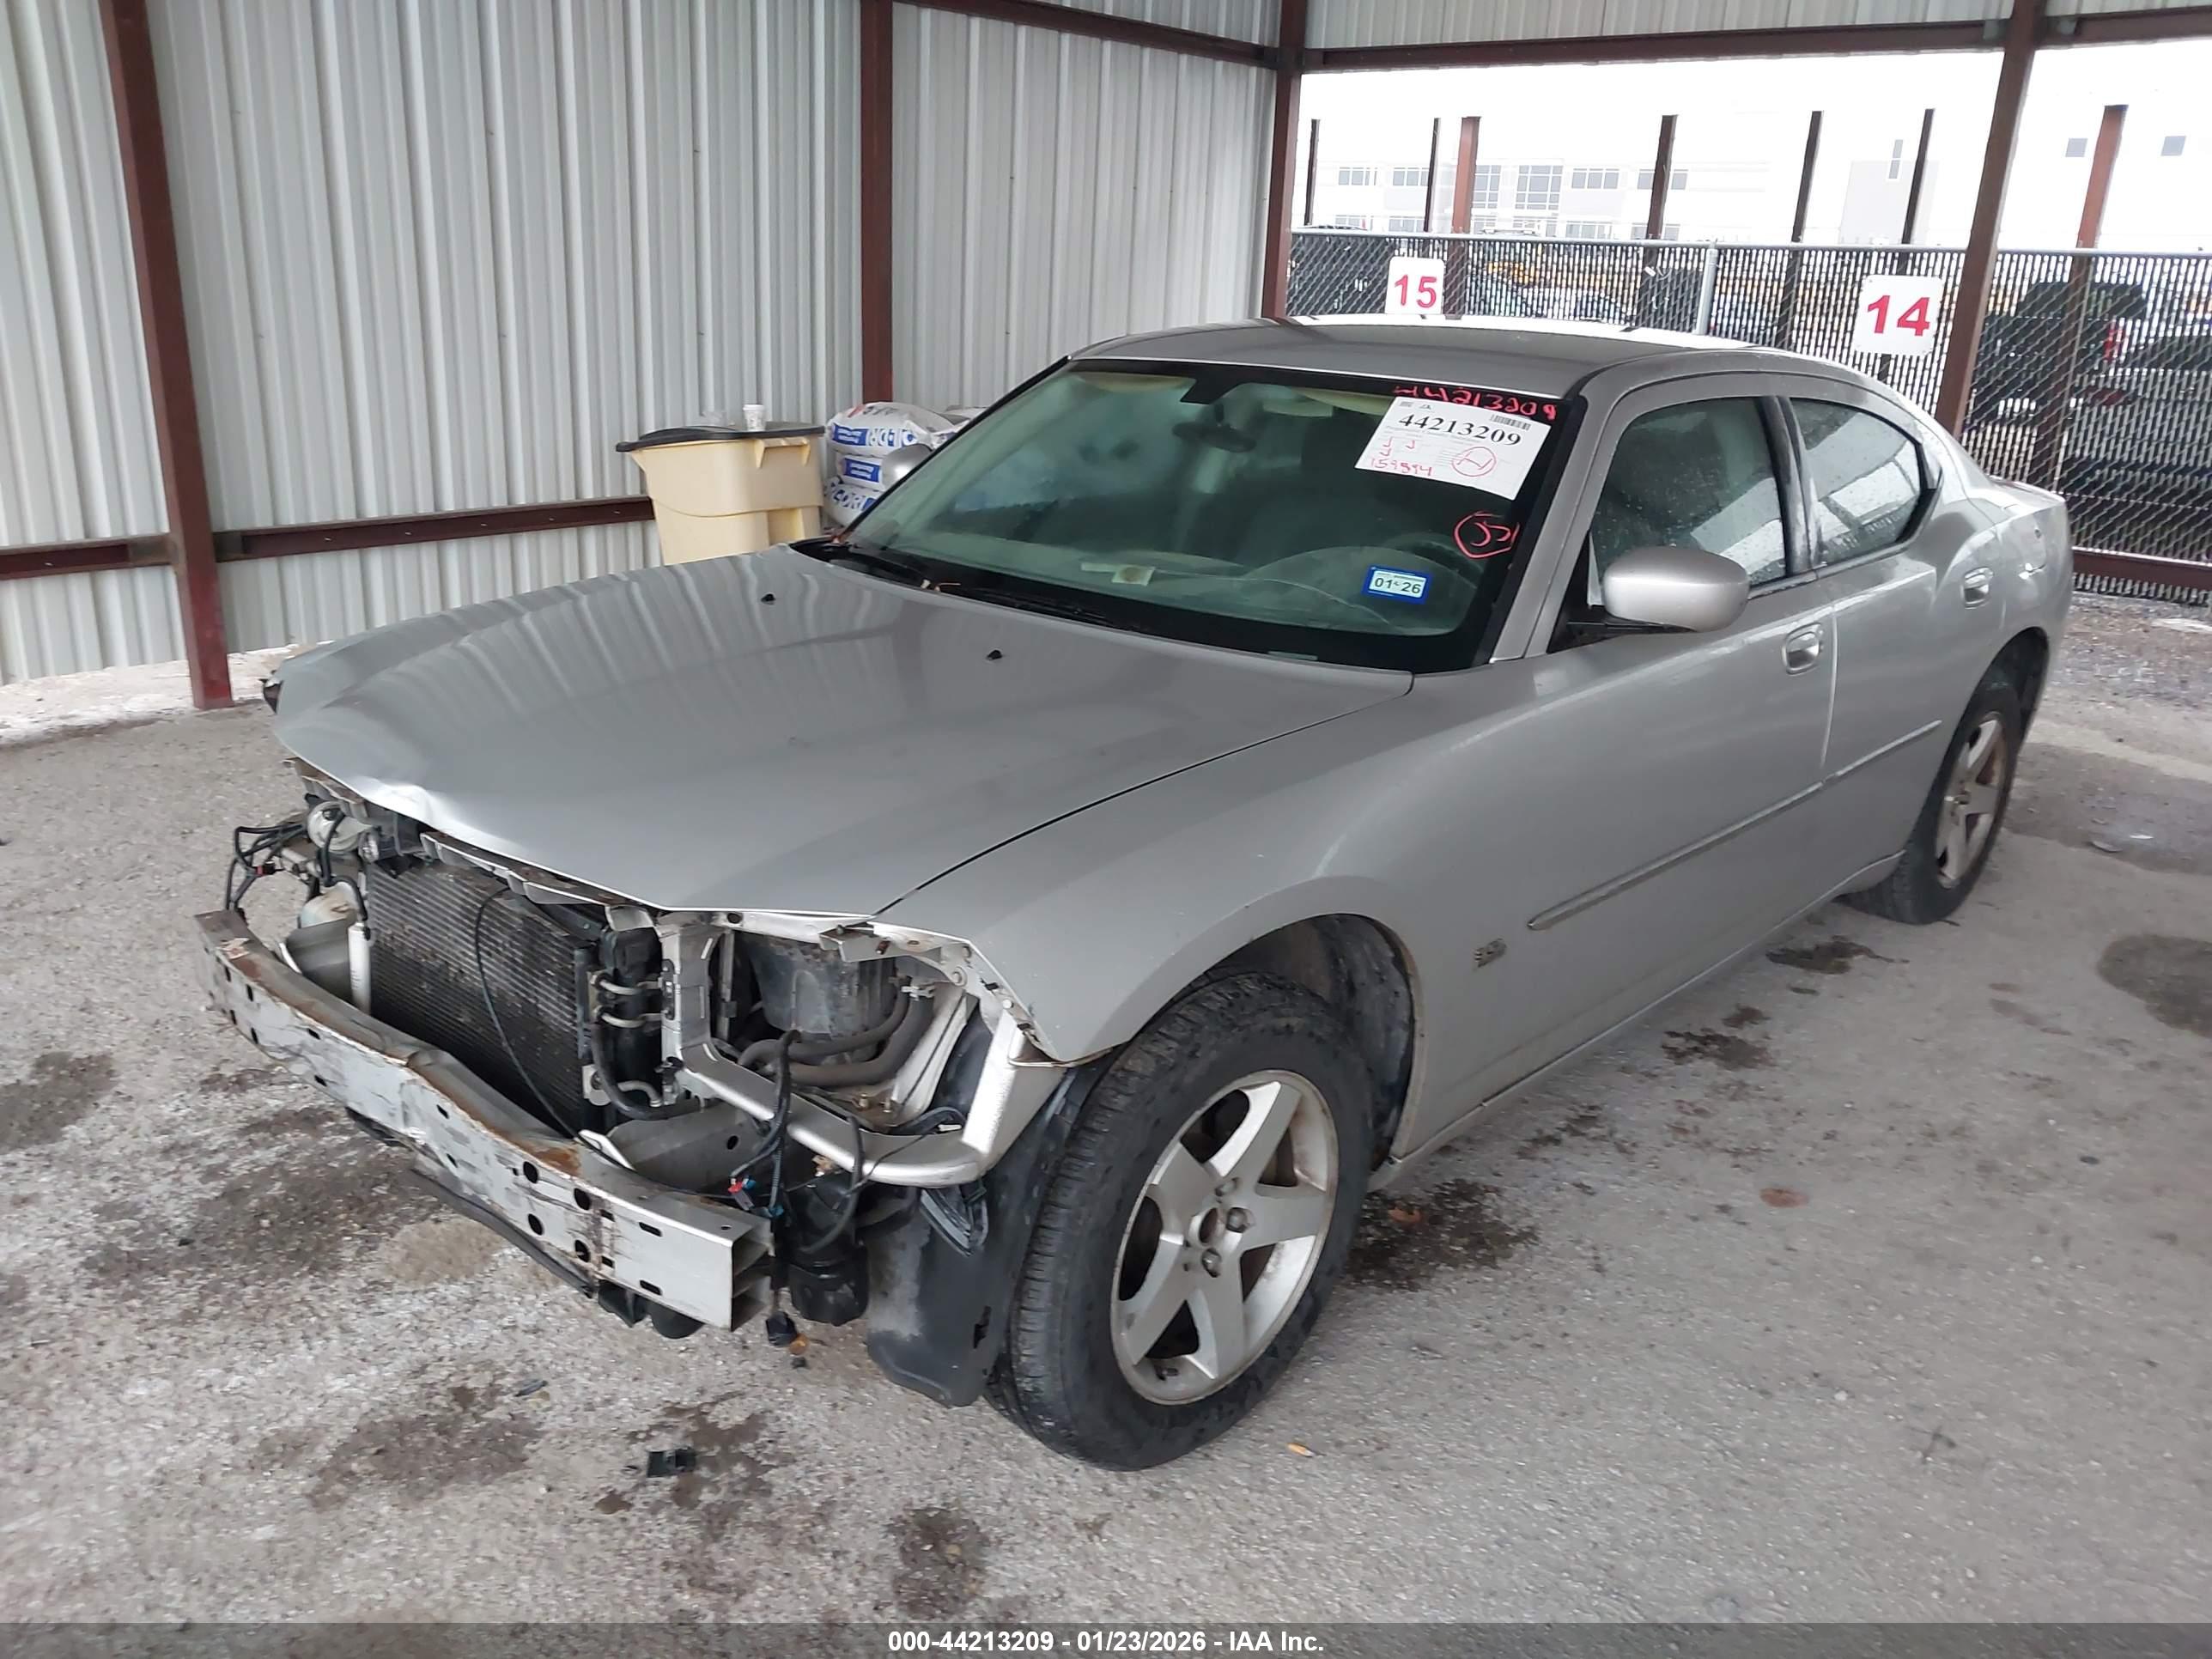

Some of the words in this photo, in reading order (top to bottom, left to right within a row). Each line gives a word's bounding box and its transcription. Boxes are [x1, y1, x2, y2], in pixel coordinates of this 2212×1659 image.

[1395, 275, 1437, 308] 15
[1868, 295, 1930, 337] 14
[1399, 412, 1522, 446] 44213209
